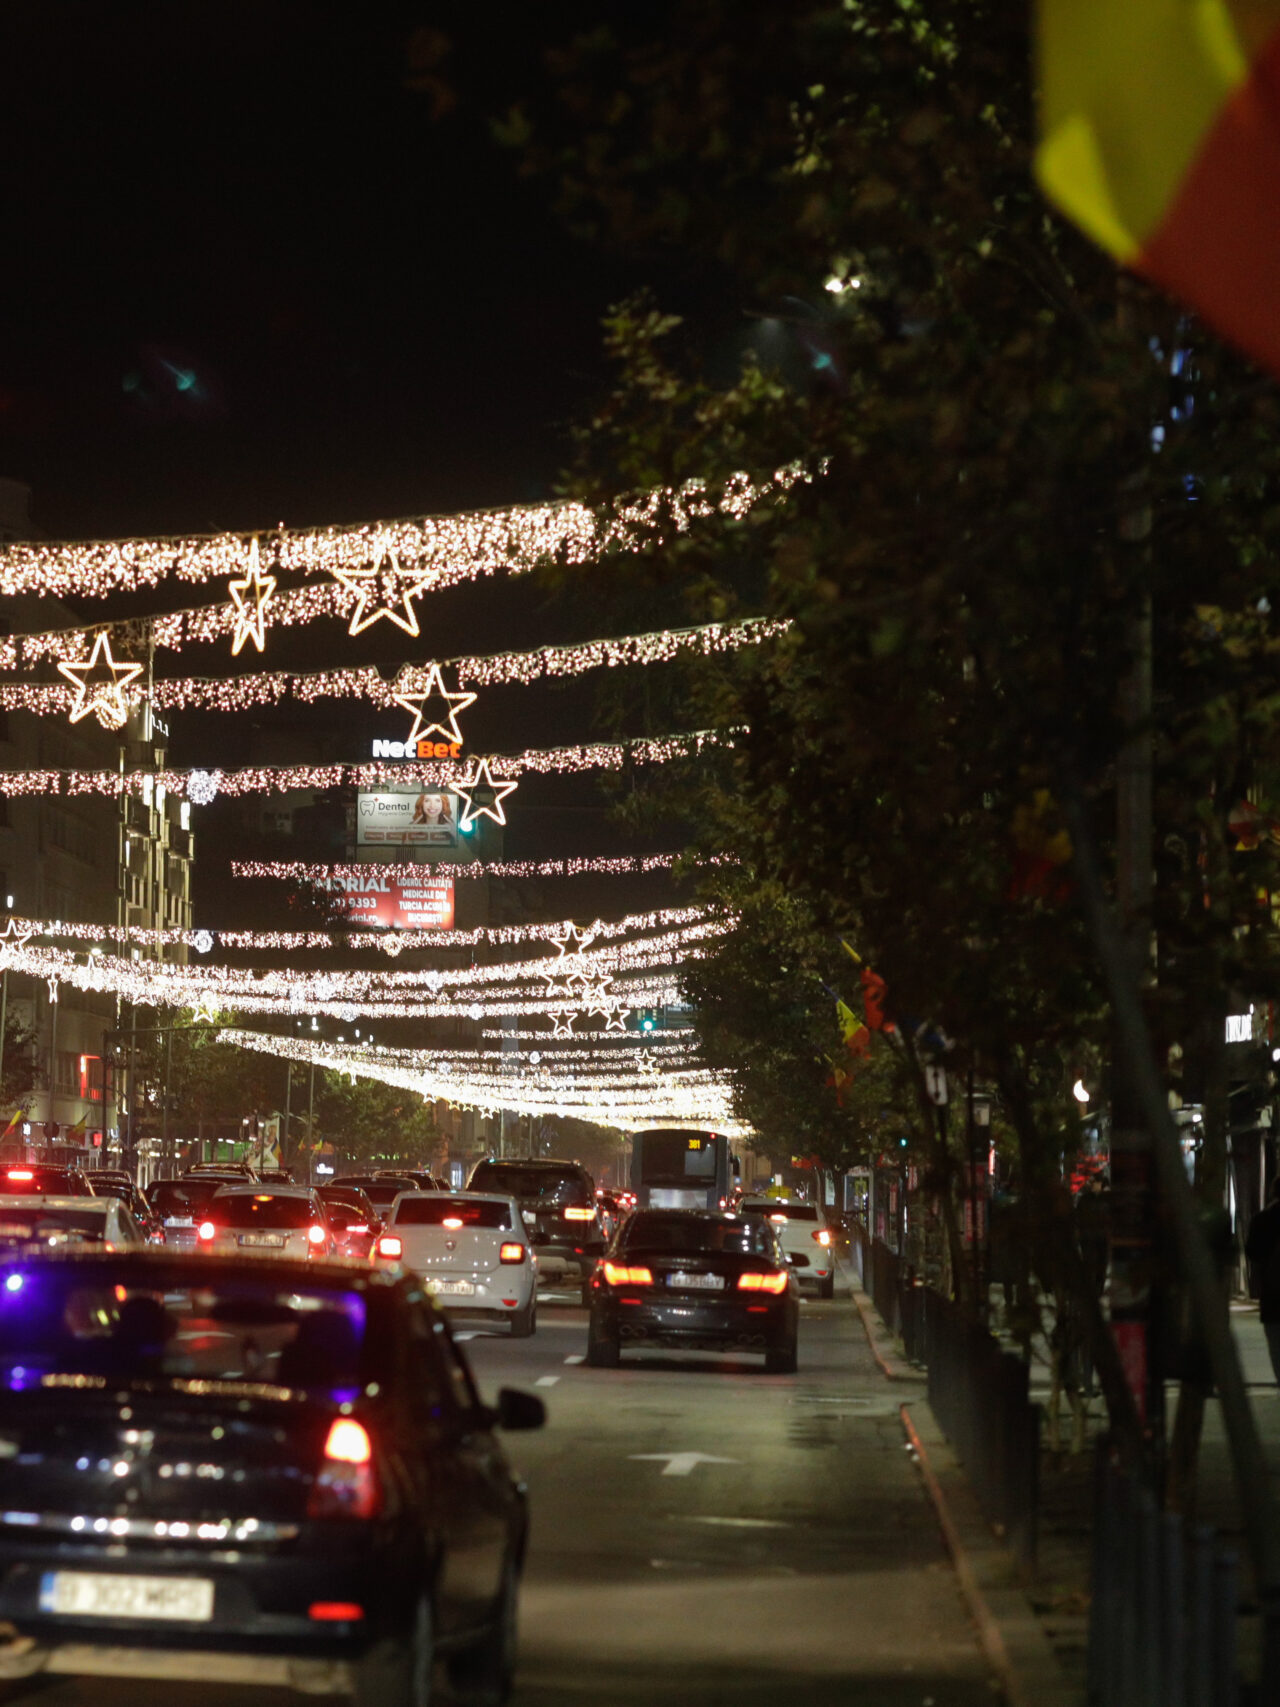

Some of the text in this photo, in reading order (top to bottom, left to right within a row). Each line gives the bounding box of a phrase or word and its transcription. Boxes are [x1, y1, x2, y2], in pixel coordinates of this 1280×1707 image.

[372, 739, 460, 758] NetBet
[378, 802, 410, 811] Dental
[402, 889, 435, 899] MEDICALE
[348, 897, 377, 909] 9393
[399, 900, 423, 911] TURCIA
